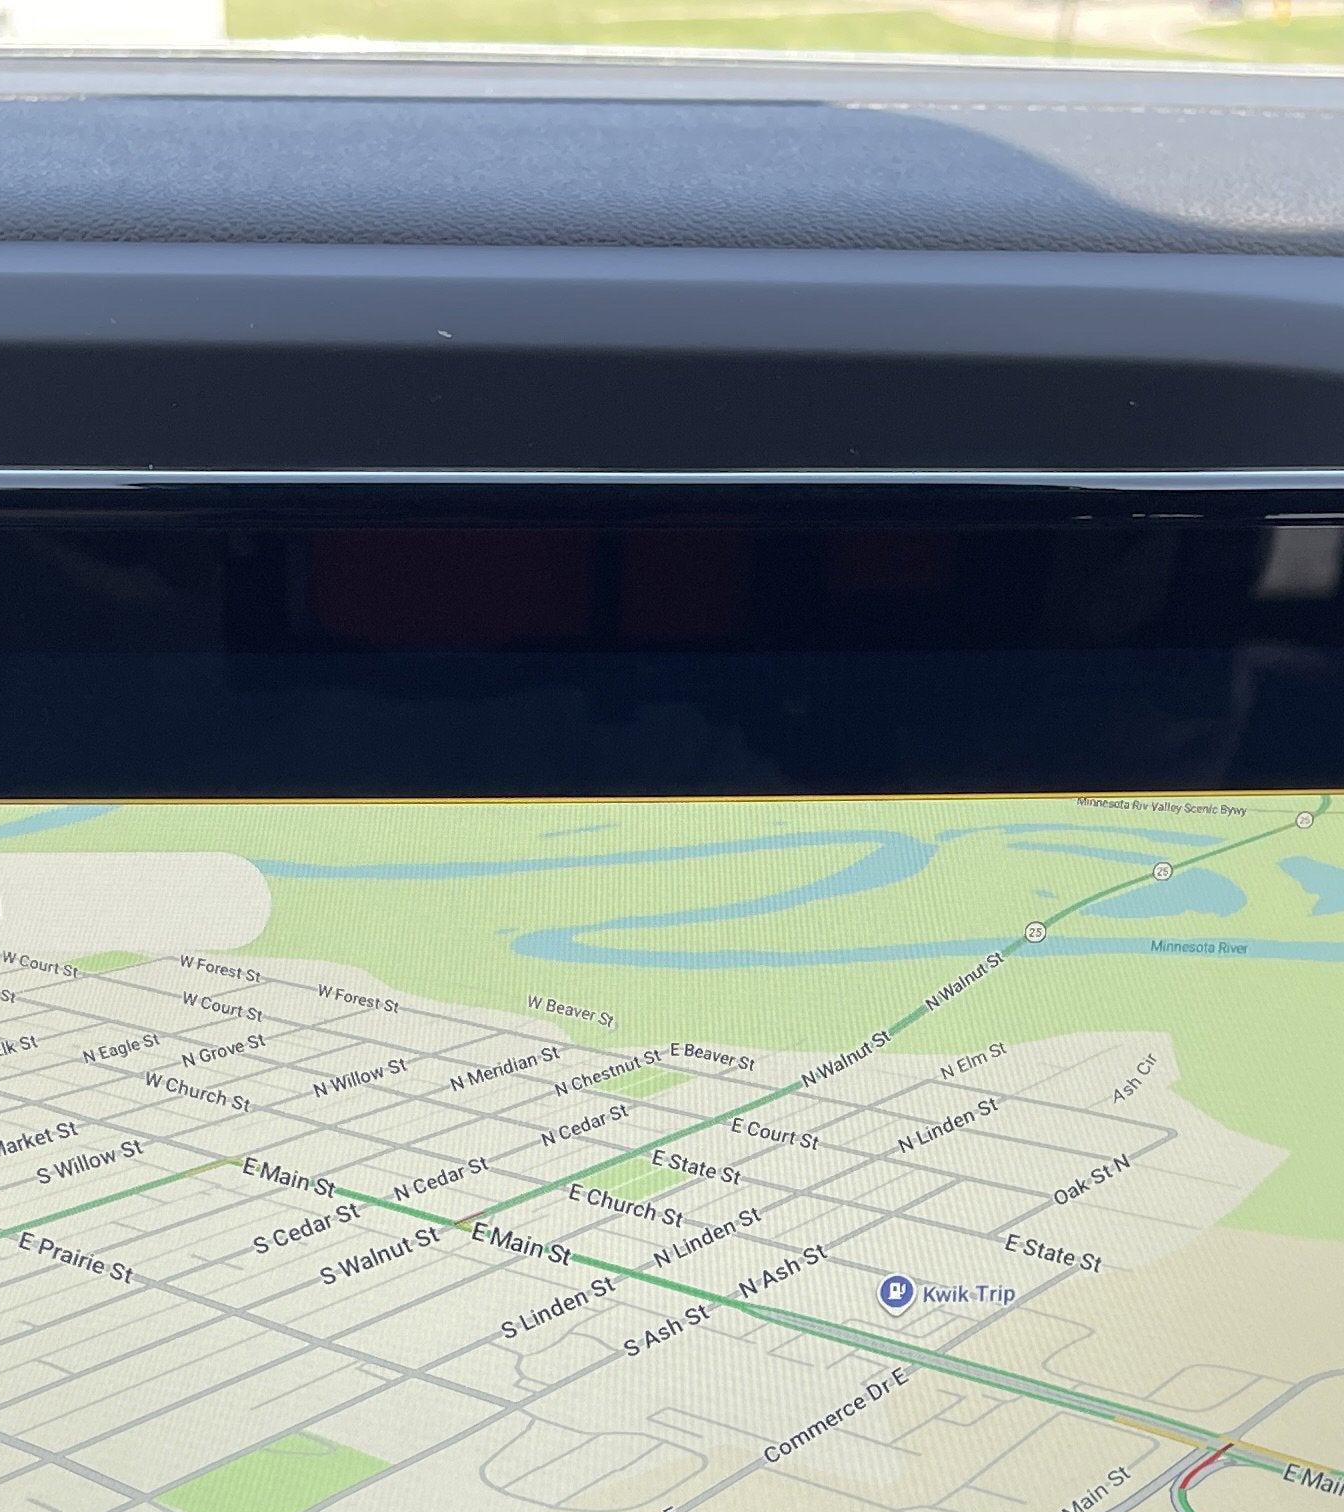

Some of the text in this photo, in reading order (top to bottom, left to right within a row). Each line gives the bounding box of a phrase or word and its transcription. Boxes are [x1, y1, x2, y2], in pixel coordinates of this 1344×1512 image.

[1152, 802, 1181, 815] Valley
[1184, 803, 1217, 814] Scenic
[1156, 867, 1169, 877] 25
[1029, 927, 1042, 938] 25
[1151, 941, 1248, 954] Minnesota River
[318, 983, 399, 1014] W Forest St
[925, 952, 1005, 1011] N Walnut St
[182, 992, 263, 1022] W Court St
[83, 1033, 160, 1064] N Eagle St
[182, 1035, 266, 1068] N Grove St
[670, 1043, 755, 1072] E Beaver St
[450, 1047, 561, 1092] N Meridian St
[554, 1050, 662, 1097] N Chestnut St
[1112, 1053, 1158, 1104] Ash Cir
[146, 1072, 250, 1112] W Church St
[56, 1122, 79, 1138] St
[731, 1118, 819, 1150] E Court St
[897, 1098, 999, 1153] N Linden St
[243, 1158, 336, 1198] E Main St
[393, 1157, 489, 1201] N Cedar St
[1054, 1153, 1131, 1204] Oak St N
[569, 1184, 683, 1228] E Church St
[18, 1232, 133, 1284] E Prairie St
[319, 1227, 440, 1285] S Walnut St
[739, 1244, 828, 1298] N Ash St
[1005, 1234, 1102, 1273] E State St
[501, 1277, 616, 1339] S Linden St
[922, 1284, 1016, 1305] Kwik Trip
[623, 1304, 710, 1356] S Ash St
[763, 1368, 909, 1465] Commerce Dr E
[1108, 1466, 1132, 1488] St
[1283, 1463, 1300, 1481] E
